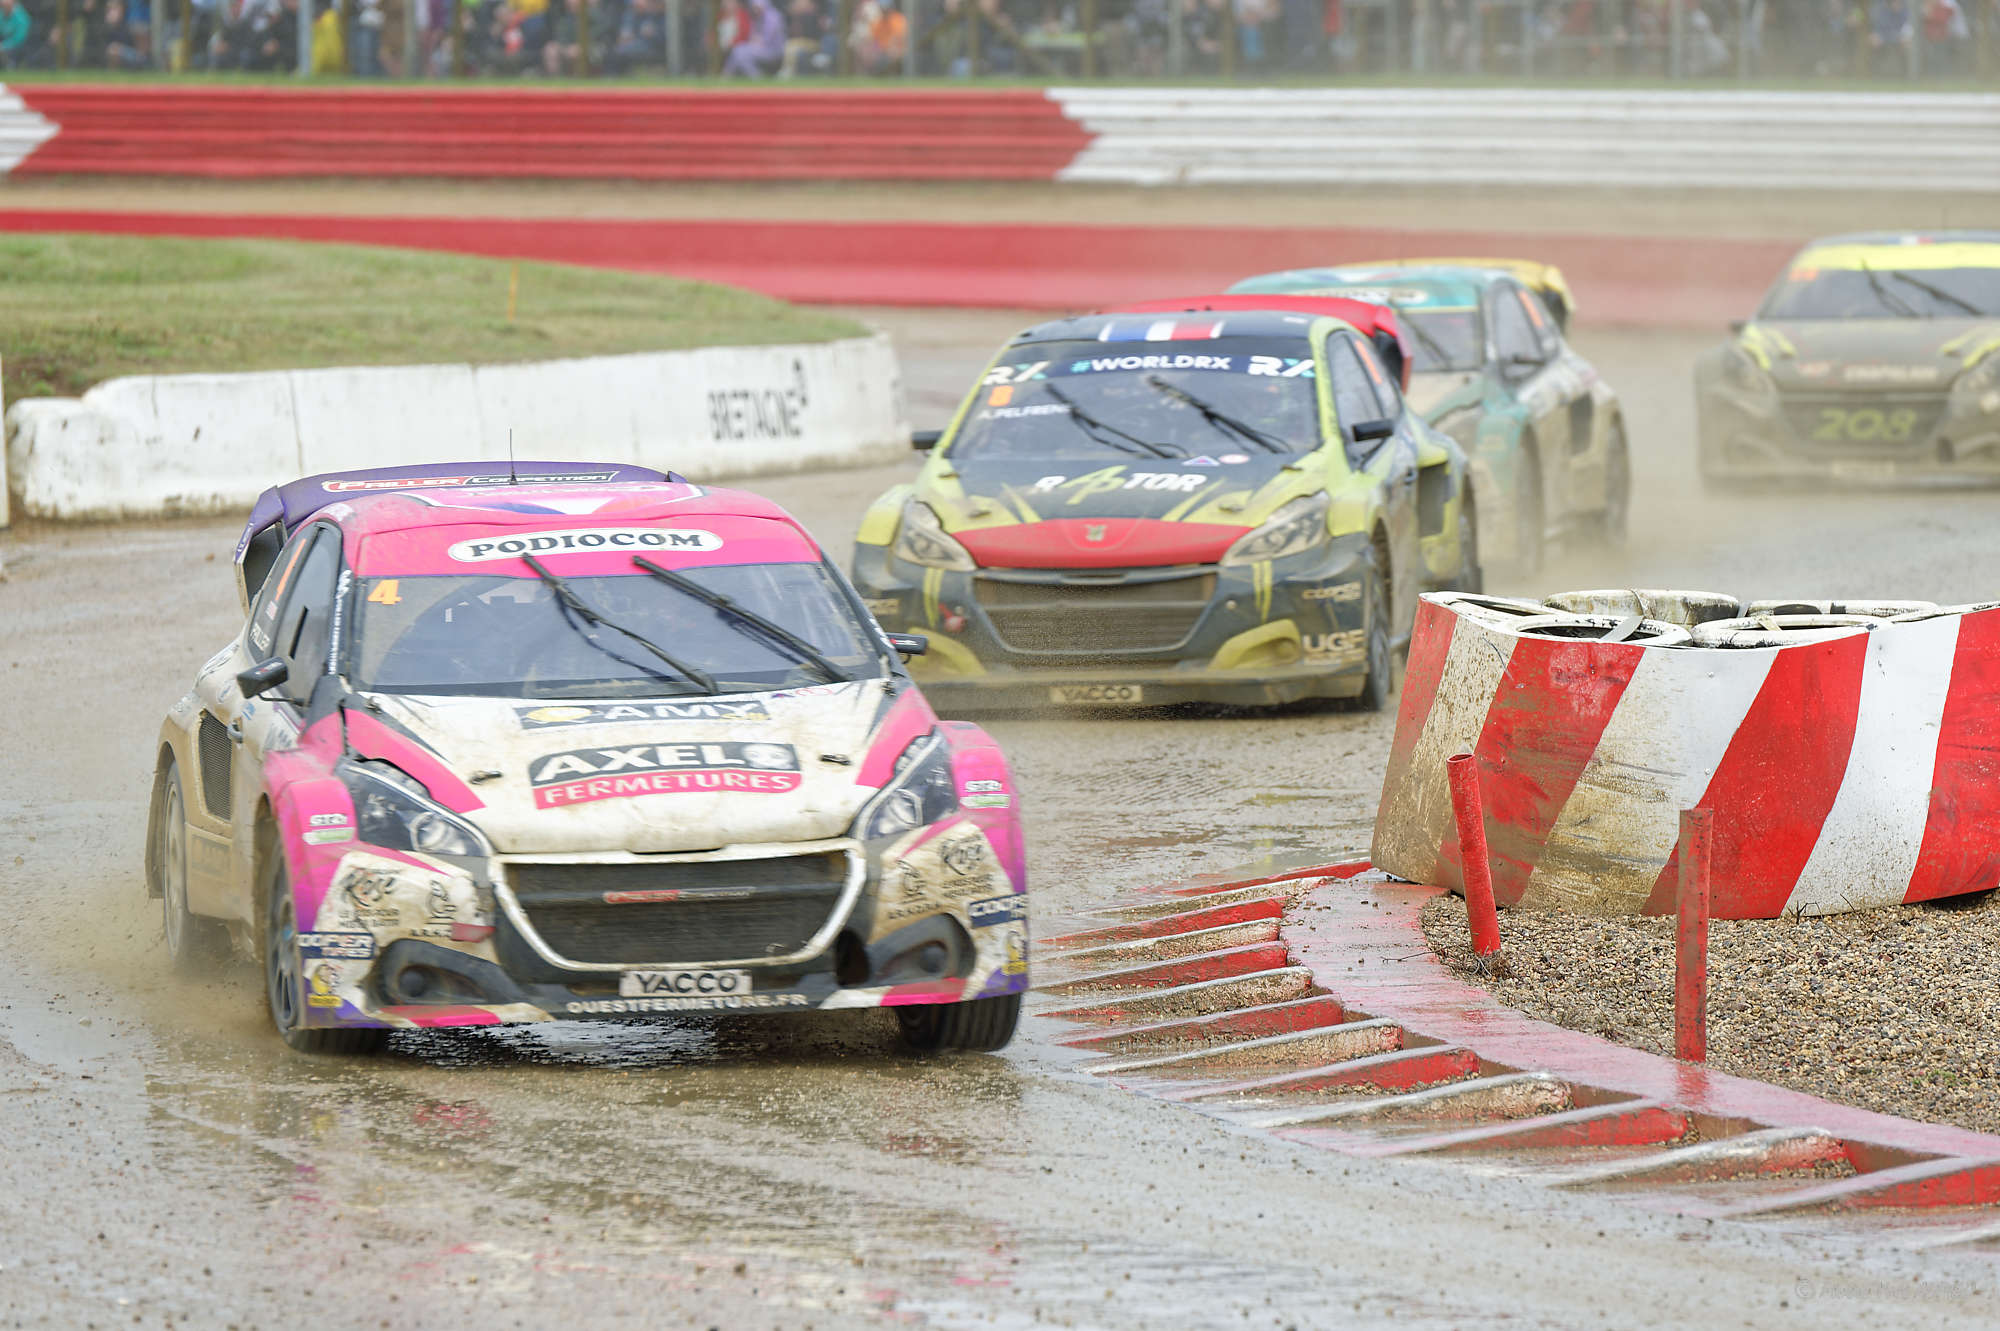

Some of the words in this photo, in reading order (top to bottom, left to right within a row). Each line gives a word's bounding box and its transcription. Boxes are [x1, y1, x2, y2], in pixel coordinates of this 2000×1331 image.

[1070, 355, 1232, 374] #WORLDRX
[1248, 355, 1316, 378] RX
[708, 388, 802, 441] BRETAGNE
[1812, 408, 1917, 440] 208
[471, 533, 702, 557] PODIOCOM
[367, 579, 402, 605] 4
[1062, 687, 1132, 700] YACCO
[535, 744, 746, 781] AXEL
[545, 773, 794, 804] FERMETURES
[636, 973, 738, 993] YACCO
